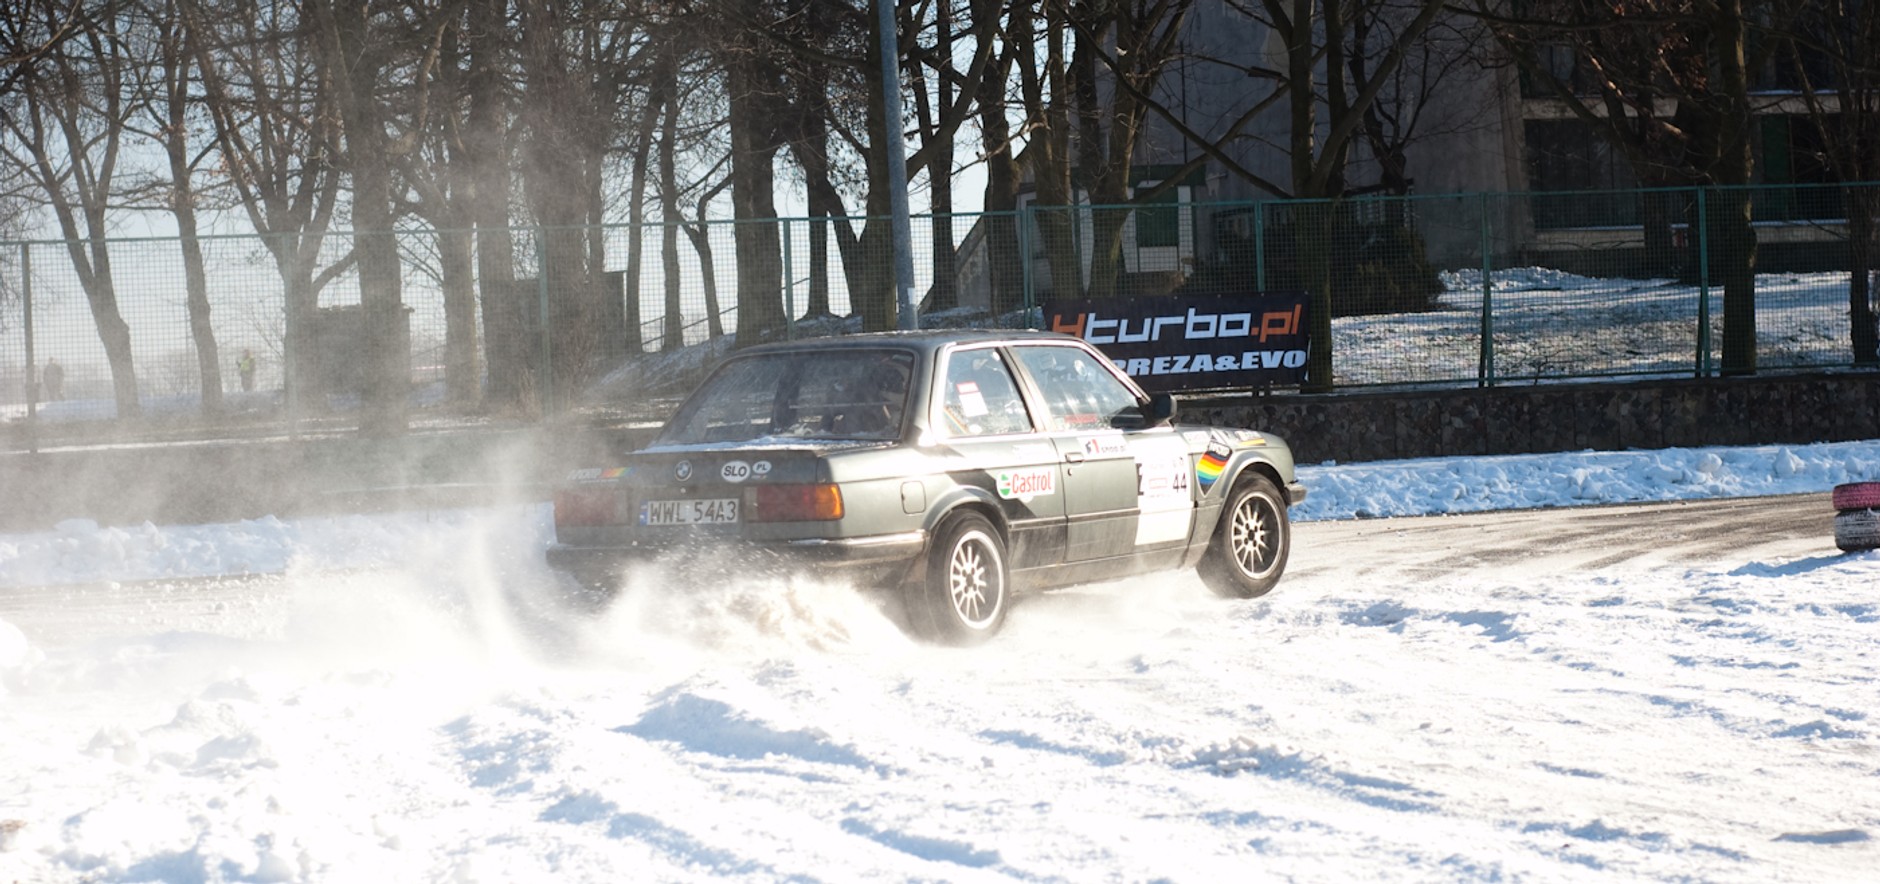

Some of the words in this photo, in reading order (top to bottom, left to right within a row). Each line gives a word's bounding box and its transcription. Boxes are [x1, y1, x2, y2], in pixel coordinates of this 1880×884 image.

[723, 465, 748, 478] SLO
[756, 463, 768, 471] PL
[1012, 471, 1052, 494] Castrol
[1172, 472, 1188, 493] 44
[650, 502, 686, 523] WWL
[694, 500, 737, 522] 54A3
